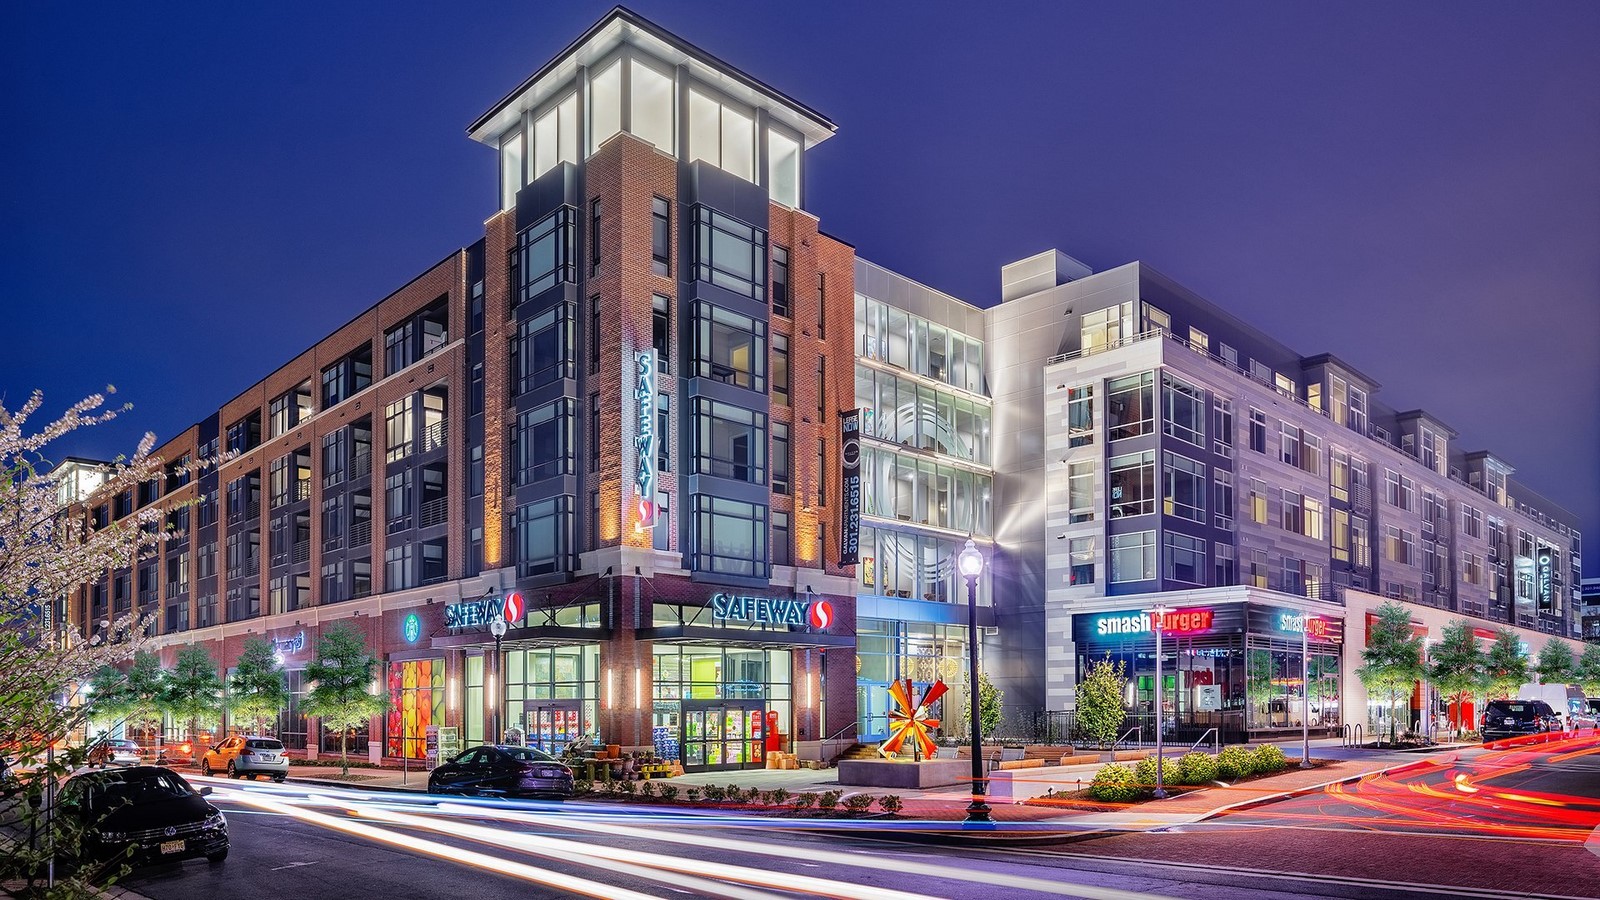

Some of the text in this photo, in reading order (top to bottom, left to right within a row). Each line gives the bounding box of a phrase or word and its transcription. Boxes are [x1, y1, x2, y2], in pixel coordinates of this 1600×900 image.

[637, 354, 653, 498] SAFEWAY
[843, 421, 859, 433] NOW
[849, 475, 860, 554] 301.231.6515
[445, 598, 506, 628] SAFEWAY
[713, 593, 810, 625] SAFEWAY
